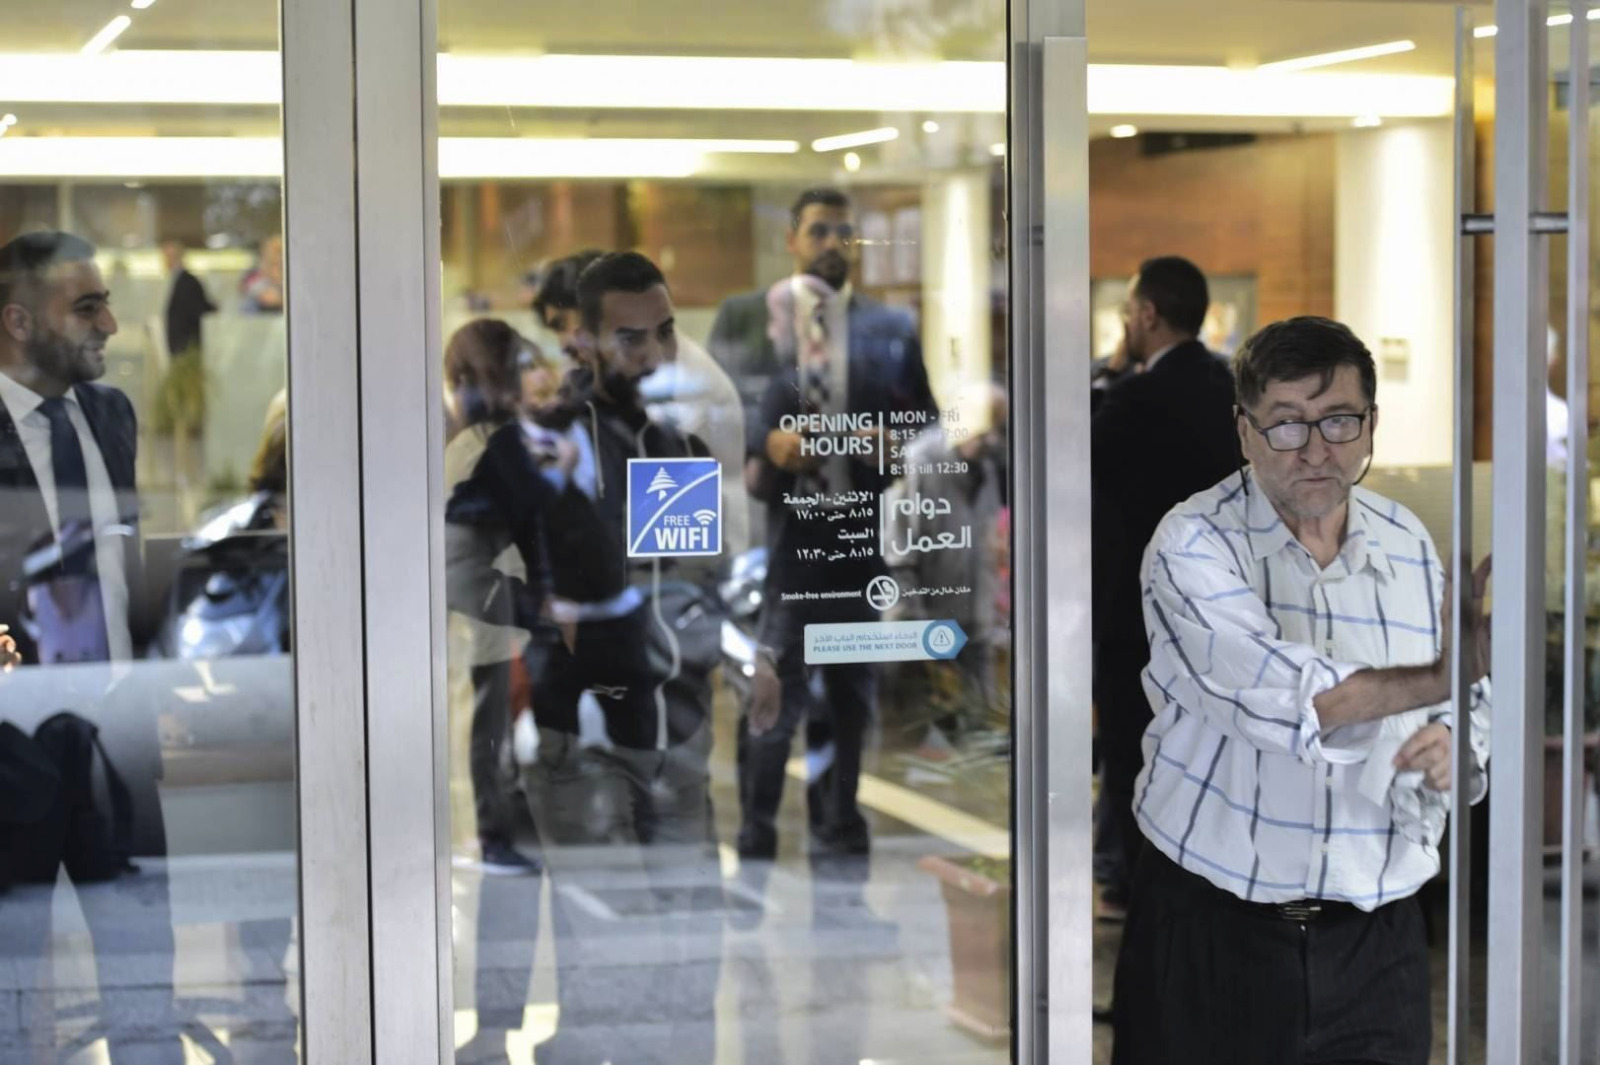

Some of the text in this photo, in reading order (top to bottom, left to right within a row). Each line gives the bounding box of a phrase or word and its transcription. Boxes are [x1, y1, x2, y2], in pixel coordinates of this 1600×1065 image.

[779, 412, 873, 434] OPENING
[890, 410, 926, 424] MON
[890, 429, 916, 441] 8:15
[801, 435, 874, 457] HOURS
[890, 461, 969, 476] 8:15 till 12:30
[892, 492, 952, 521] دوام
[663, 515, 691, 527] FREE
[827, 510, 846, 522] حتى
[654, 526, 709, 550] WIFI
[837, 527, 874, 544] السبت
[891, 525, 972, 556] العمل
[828, 550, 847, 561] حتى
[813, 641, 918, 653] PLEASE USE THE NEXT DOOR
